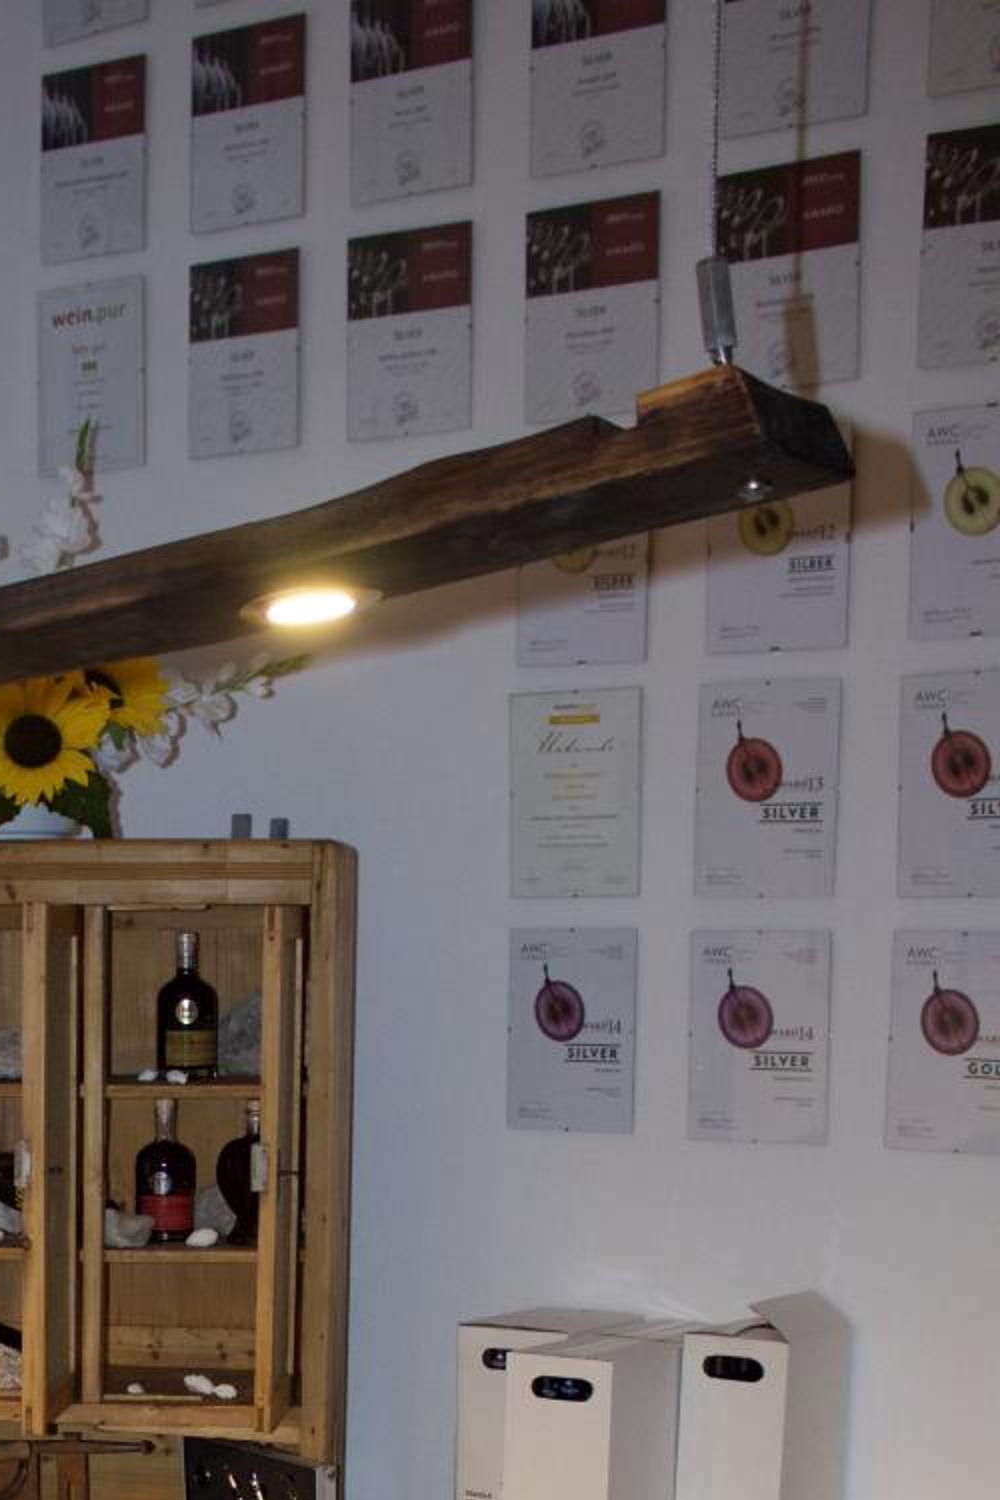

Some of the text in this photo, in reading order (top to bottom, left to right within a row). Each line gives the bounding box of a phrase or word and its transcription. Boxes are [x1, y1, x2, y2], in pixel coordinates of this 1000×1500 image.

[761, 806, 820, 820] SILVER
[566, 1046, 619, 1060] SILVER
[752, 1054, 811, 1068] SILVER
